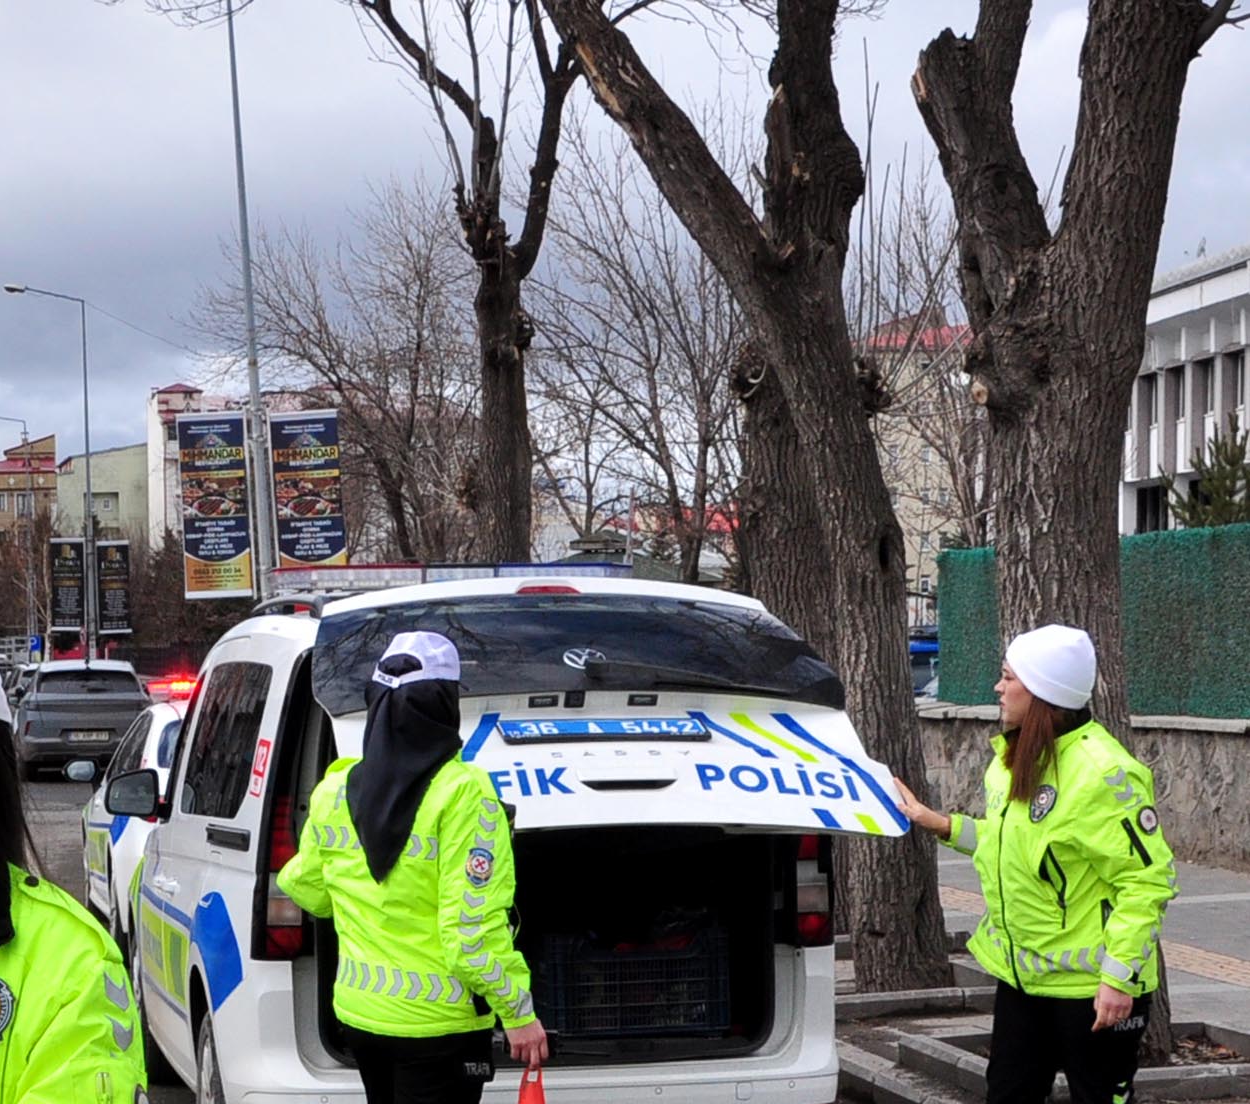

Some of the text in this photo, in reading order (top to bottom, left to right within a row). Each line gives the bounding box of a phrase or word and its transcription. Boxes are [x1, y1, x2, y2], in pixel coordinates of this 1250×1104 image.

[519, 720, 699, 735] 36 A 5442
[487, 762, 862, 801] FİK POLİSİ
